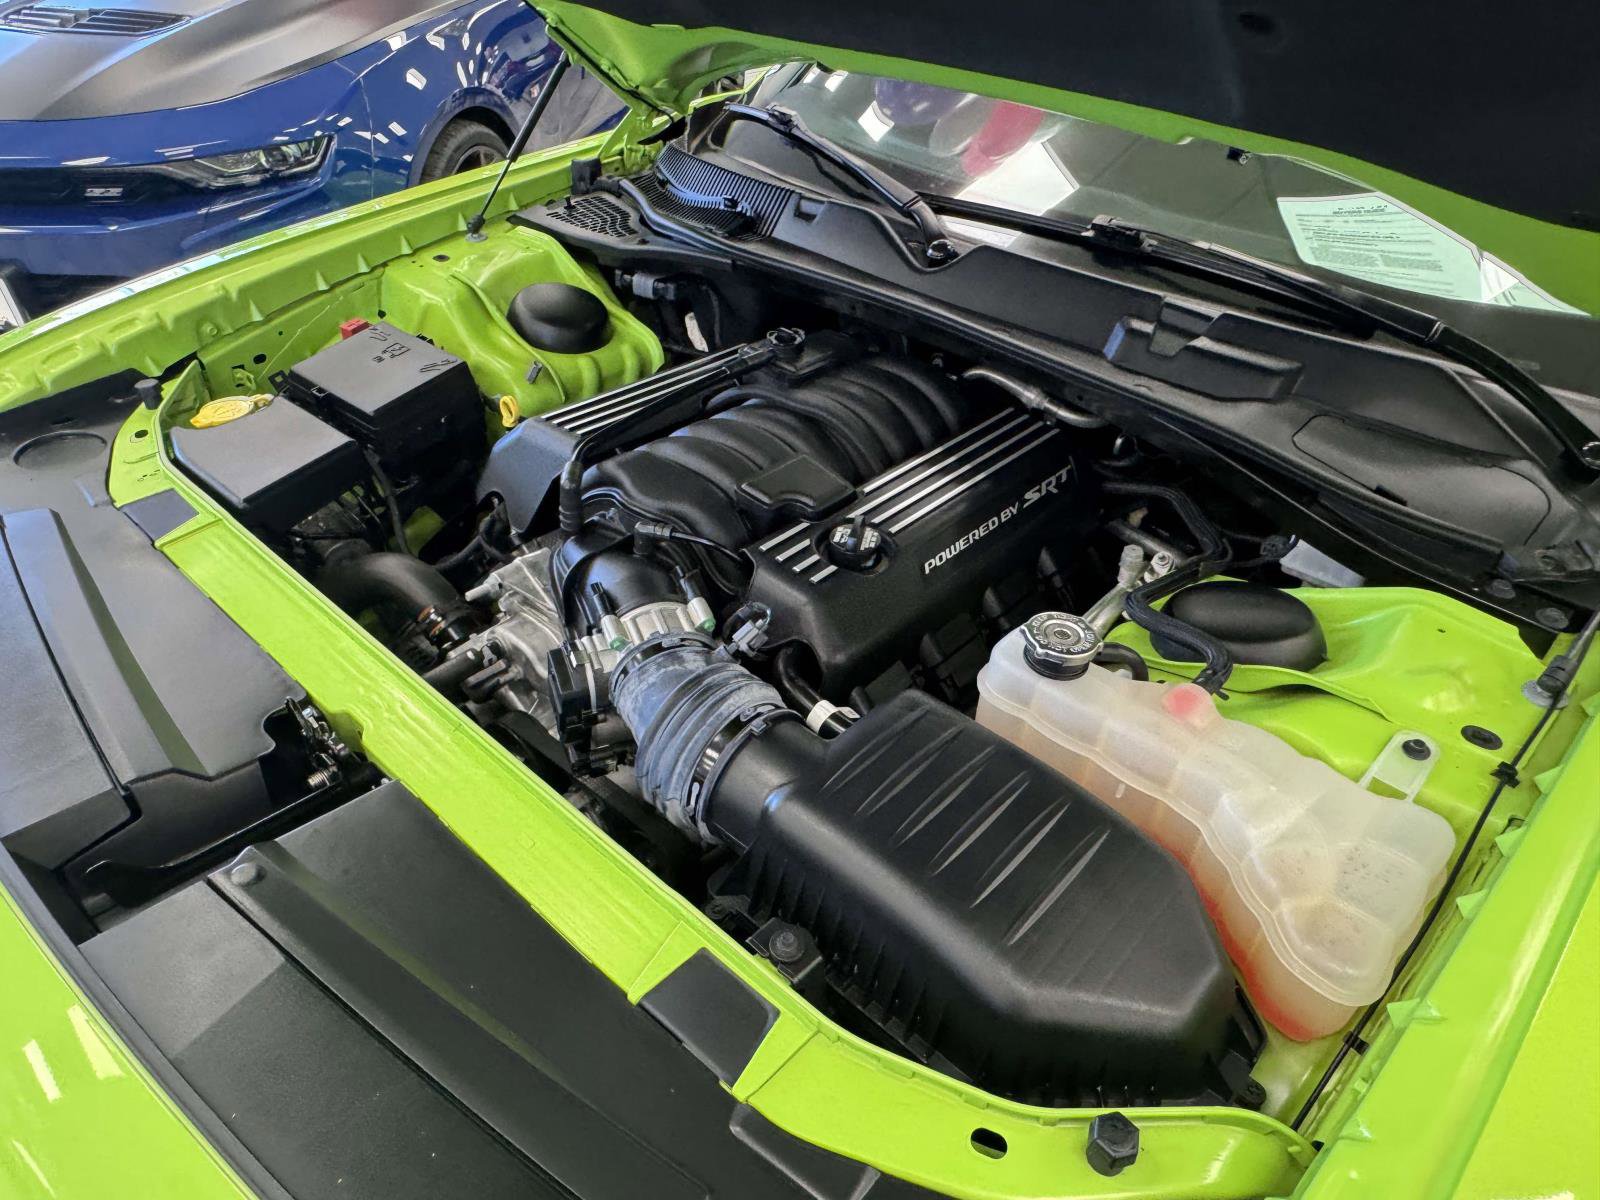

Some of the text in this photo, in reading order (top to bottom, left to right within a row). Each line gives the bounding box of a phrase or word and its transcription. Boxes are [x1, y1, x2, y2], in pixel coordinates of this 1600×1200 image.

[924, 516, 999, 575] POWERED
[1000, 501, 1019, 523] BY
[1023, 464, 1072, 509] SRT
